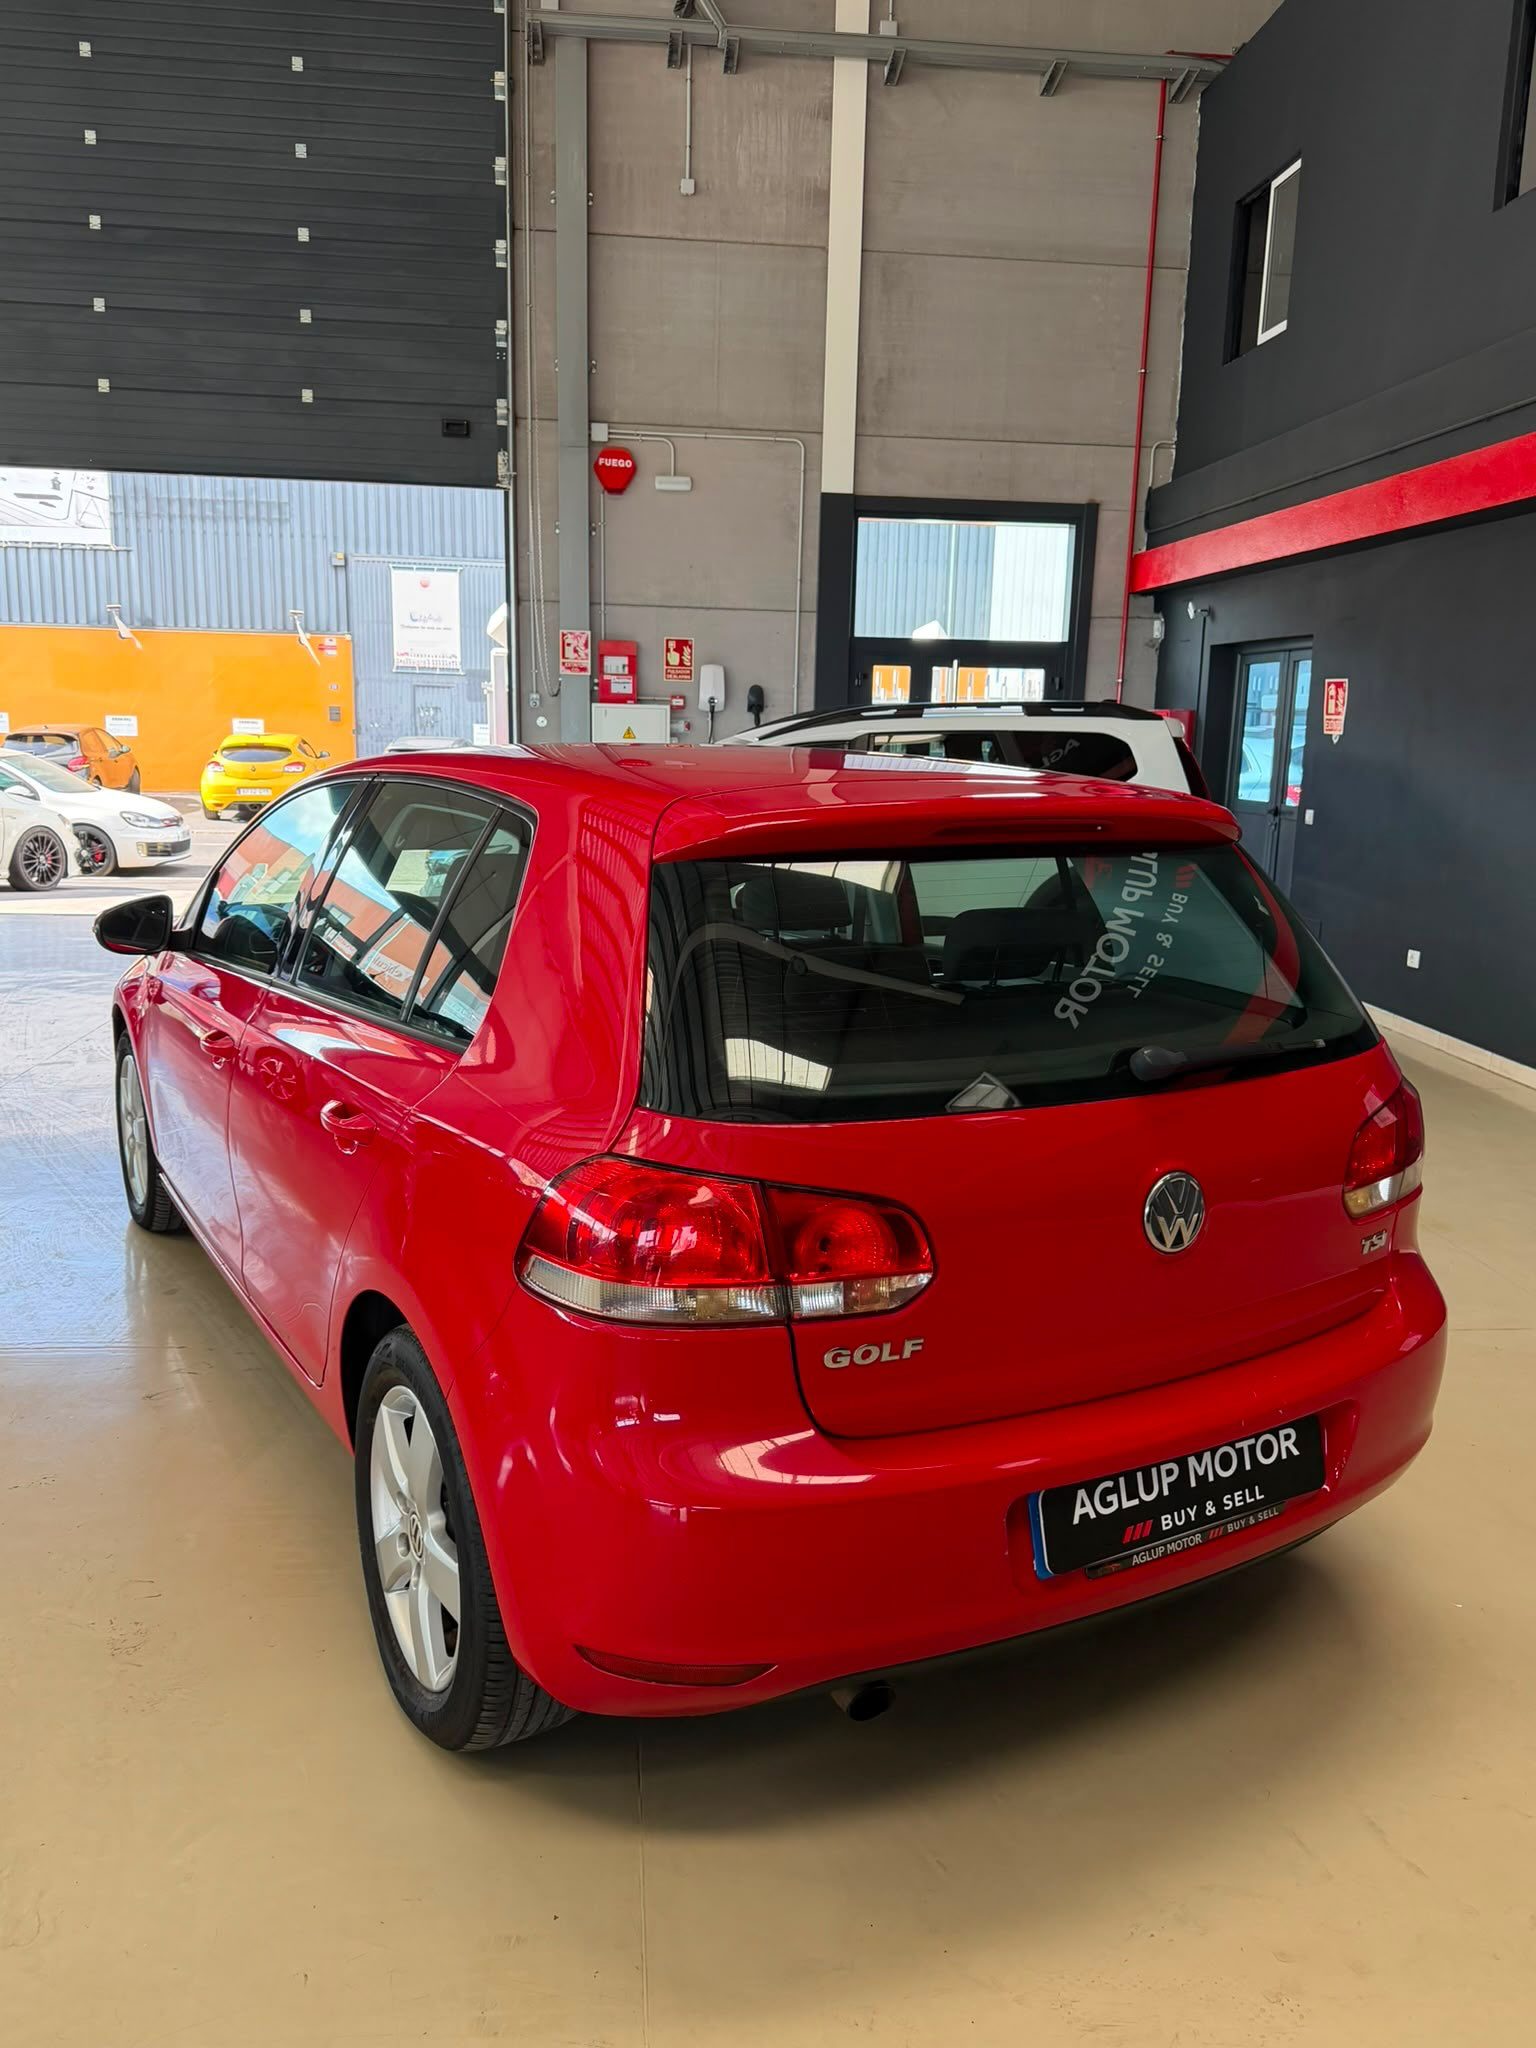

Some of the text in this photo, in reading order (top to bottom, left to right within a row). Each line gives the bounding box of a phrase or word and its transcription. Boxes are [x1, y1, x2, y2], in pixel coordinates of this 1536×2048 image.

[598, 457, 633, 468] FUEGO
[1361, 1230, 1387, 1255] TSI
[823, 1338, 924, 1369] GOLF
[1072, 1427, 1300, 1525] AGLUP MOTOR
[1161, 1485, 1265, 1531] BUY & SELL
[1132, 1507, 1279, 1566] AGLUP MOTOR BUY & SELL
